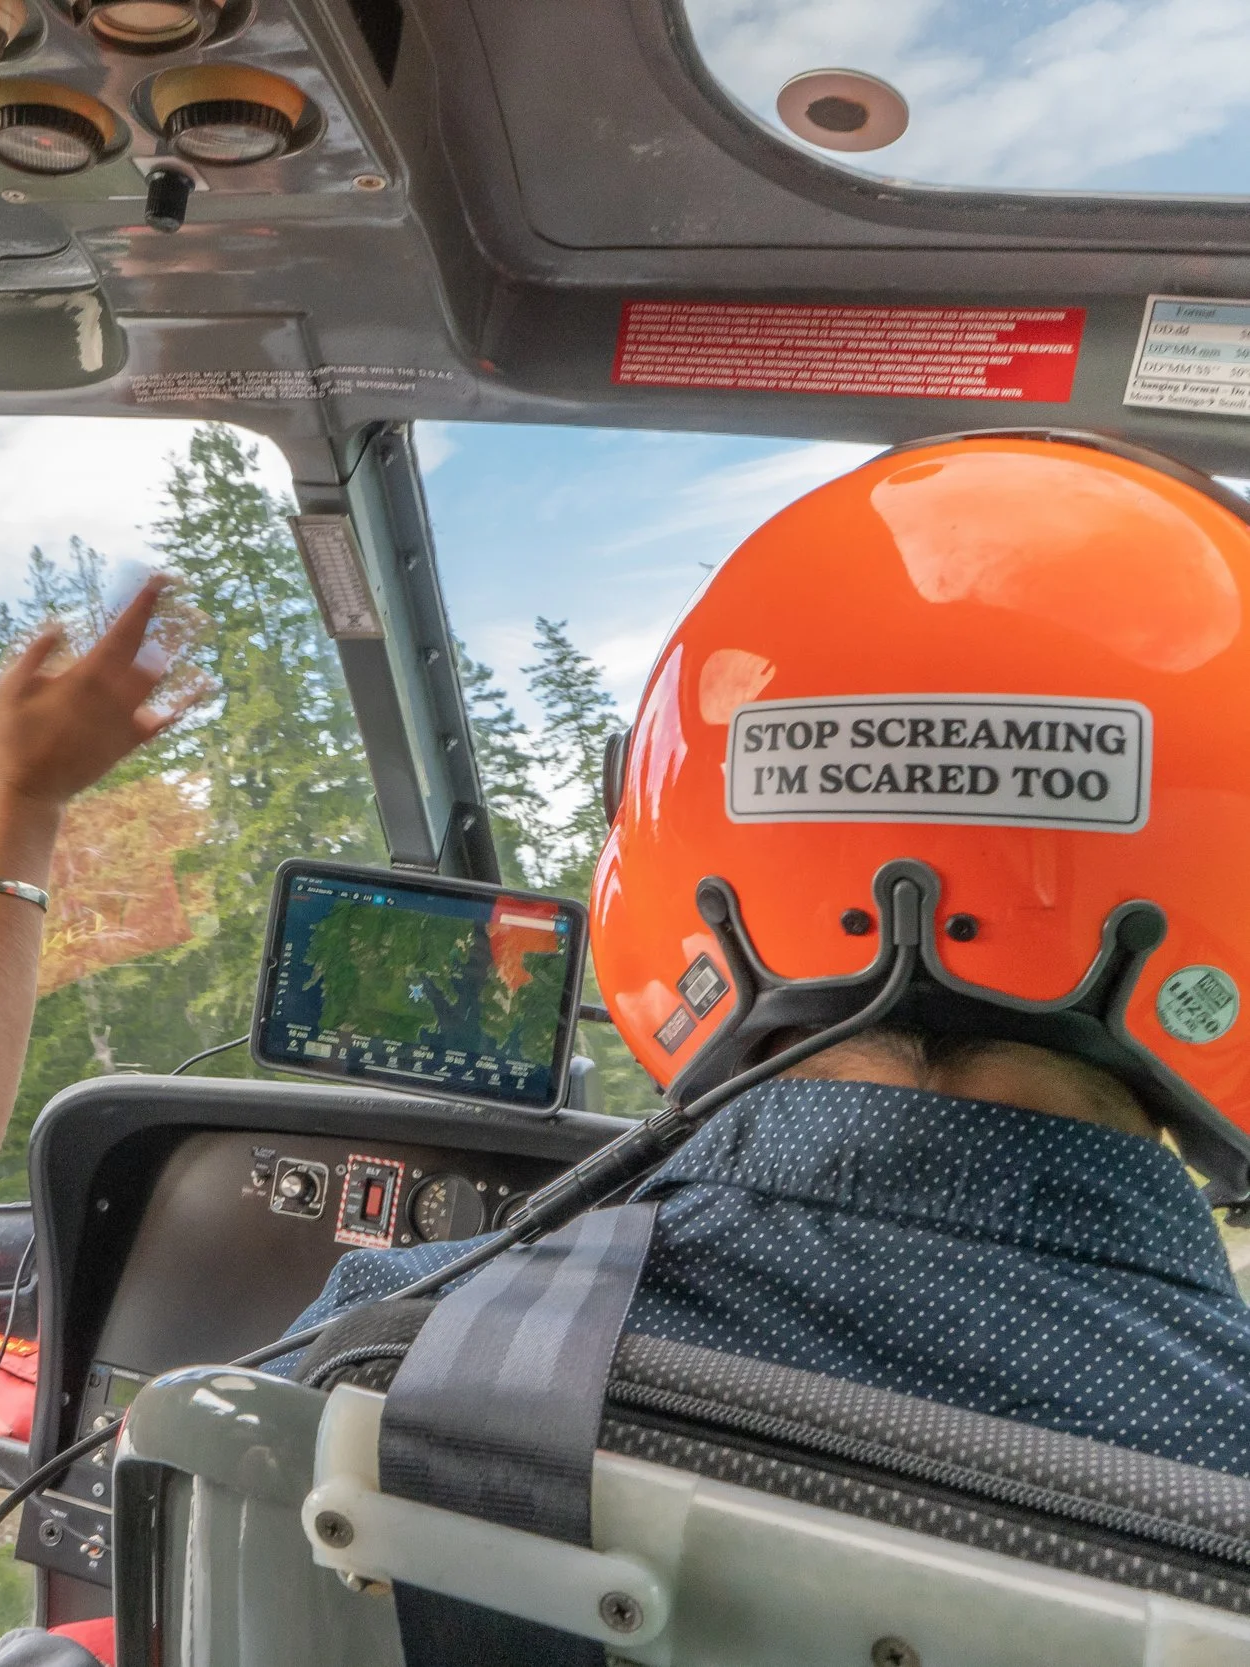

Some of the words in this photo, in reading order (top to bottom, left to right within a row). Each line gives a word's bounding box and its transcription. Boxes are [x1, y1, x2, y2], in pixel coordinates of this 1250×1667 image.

[743, 718, 840, 753] STOP
[851, 718, 1128, 757] SCREAMING
[753, 764, 808, 795] I'M
[819, 763, 1000, 795] SCARED
[1011, 767, 1109, 802] TOO
